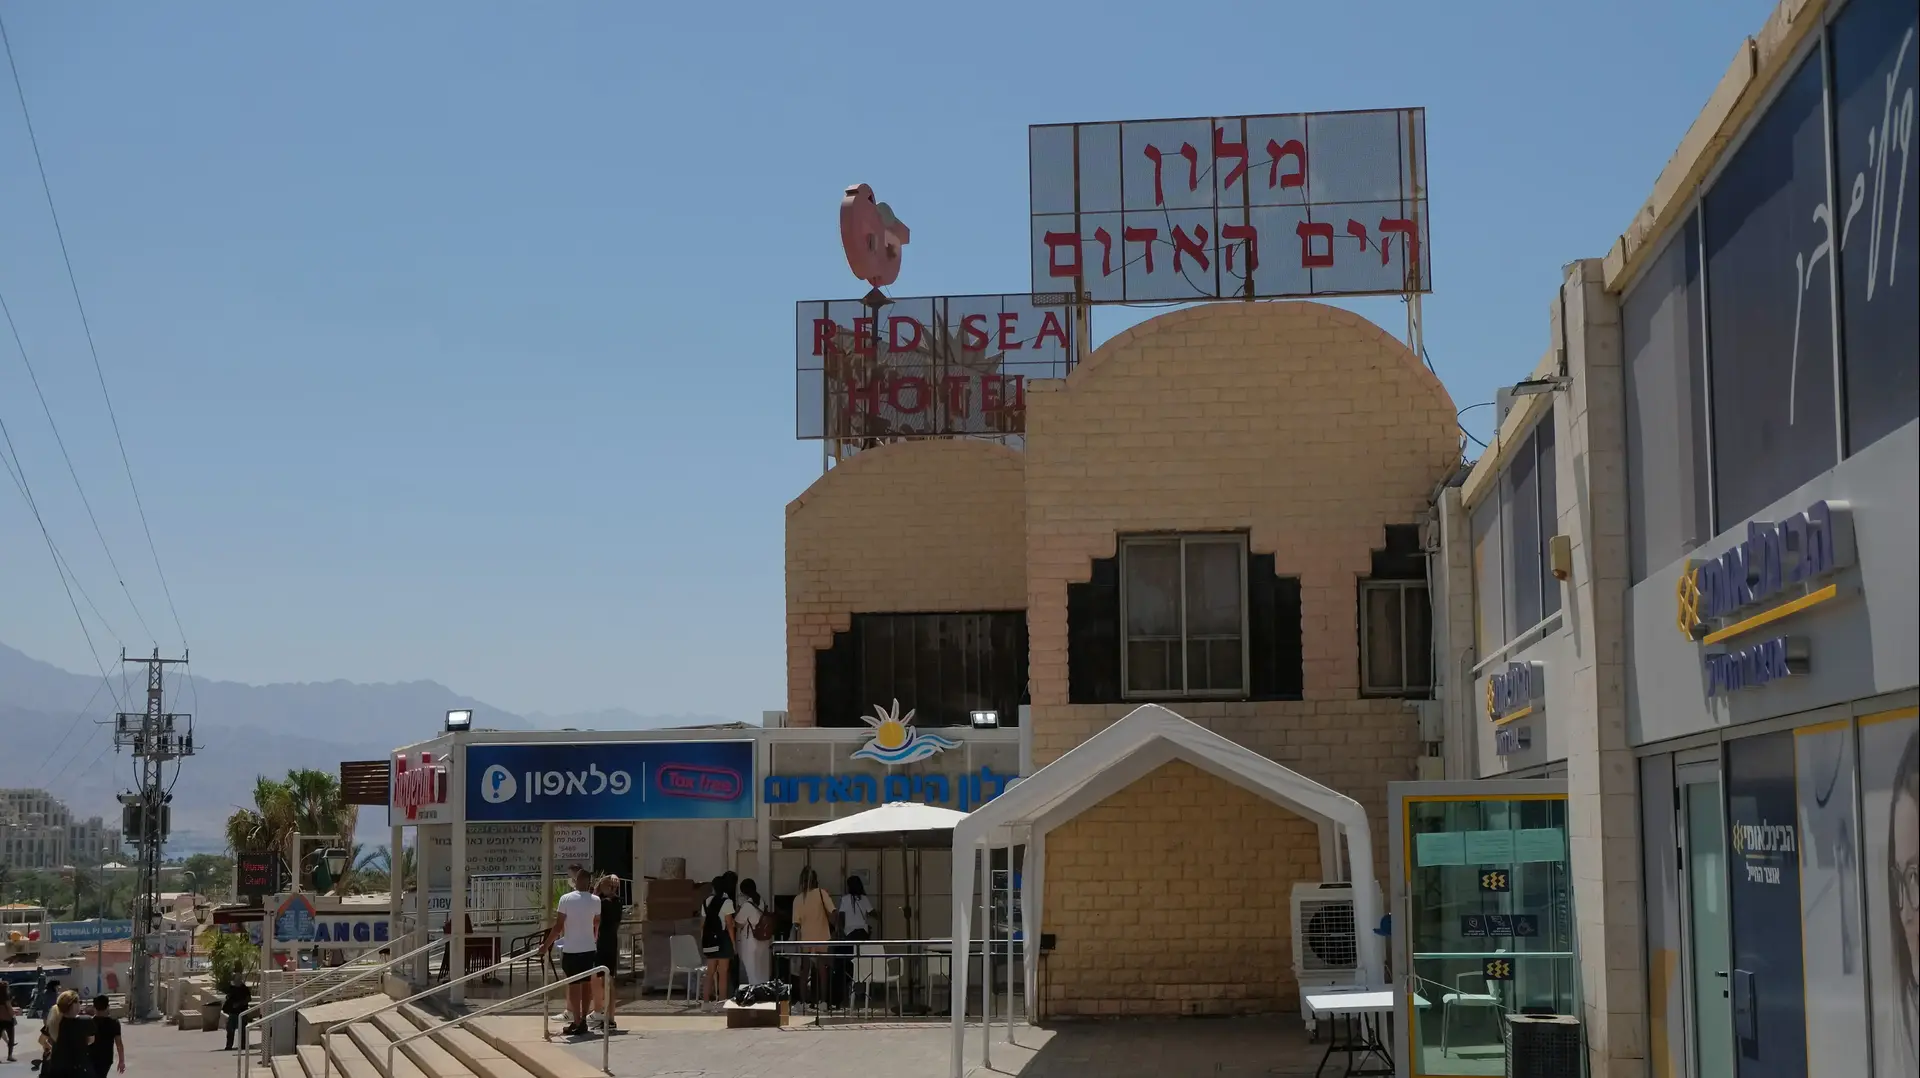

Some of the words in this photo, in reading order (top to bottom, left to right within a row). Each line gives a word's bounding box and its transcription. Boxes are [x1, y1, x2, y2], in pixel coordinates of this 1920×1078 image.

[1144, 127, 1306, 206] מלון
[1044, 223, 1258, 277] האדום
[1297, 217, 1420, 268] הים
[812, 316, 922, 356] RED
[962, 311, 1070, 351] SEA
[525, 763, 631, 803] פלאפון
[764, 774, 877, 804] האדום
[885, 774, 947, 804] הים
[1744, 819, 1795, 851] הבינלאומי
[298, 922, 389, 942] ANGE
